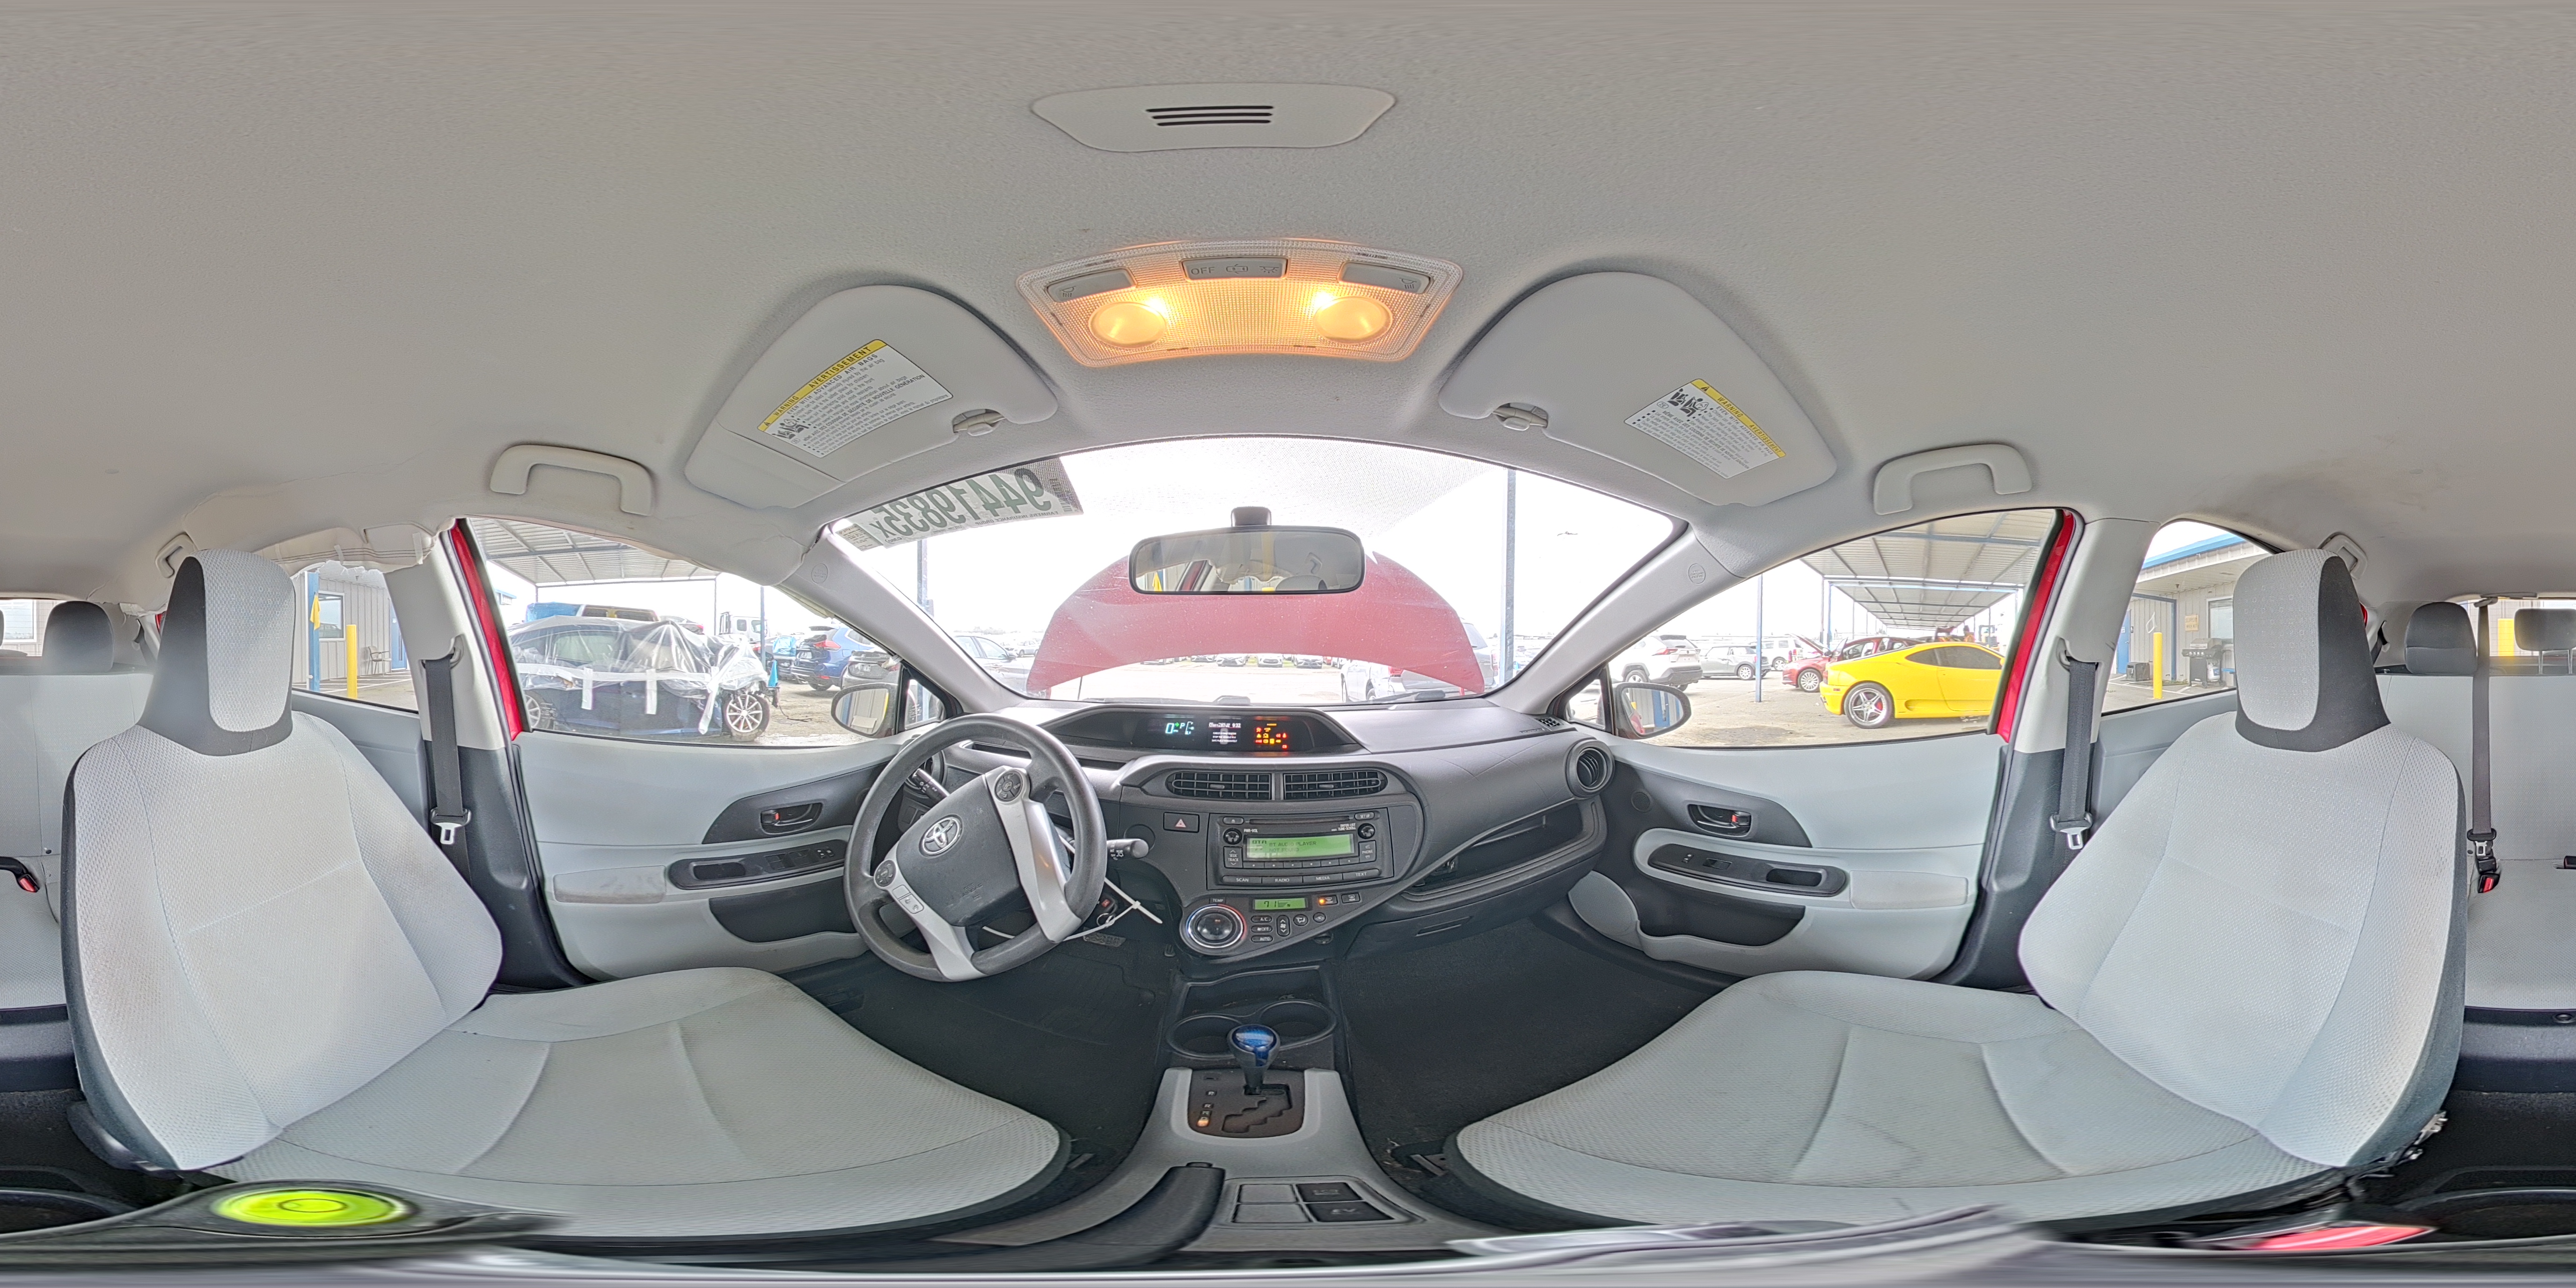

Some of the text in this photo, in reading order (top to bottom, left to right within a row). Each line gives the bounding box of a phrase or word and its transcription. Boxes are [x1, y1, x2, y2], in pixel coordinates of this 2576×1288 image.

[773, 346, 872, 416] WARNING AVERTISSEMENT
[786, 405, 799, 414] EVEN
[799, 395, 812, 404] WITH
[812, 374, 843, 395] ADVANCED
[857, 353, 878, 366] BAGS
[871, 387, 895, 400] NOUVELLE
[1716, 406, 1729, 415] EVEN
[1728, 416, 1740, 424] WITH
[1739, 425, 1758, 440] ADVANCED
[1716, 397, 1743, 417] WARNING
[1748, 424, 1781, 453] AVERTISSEMENT
